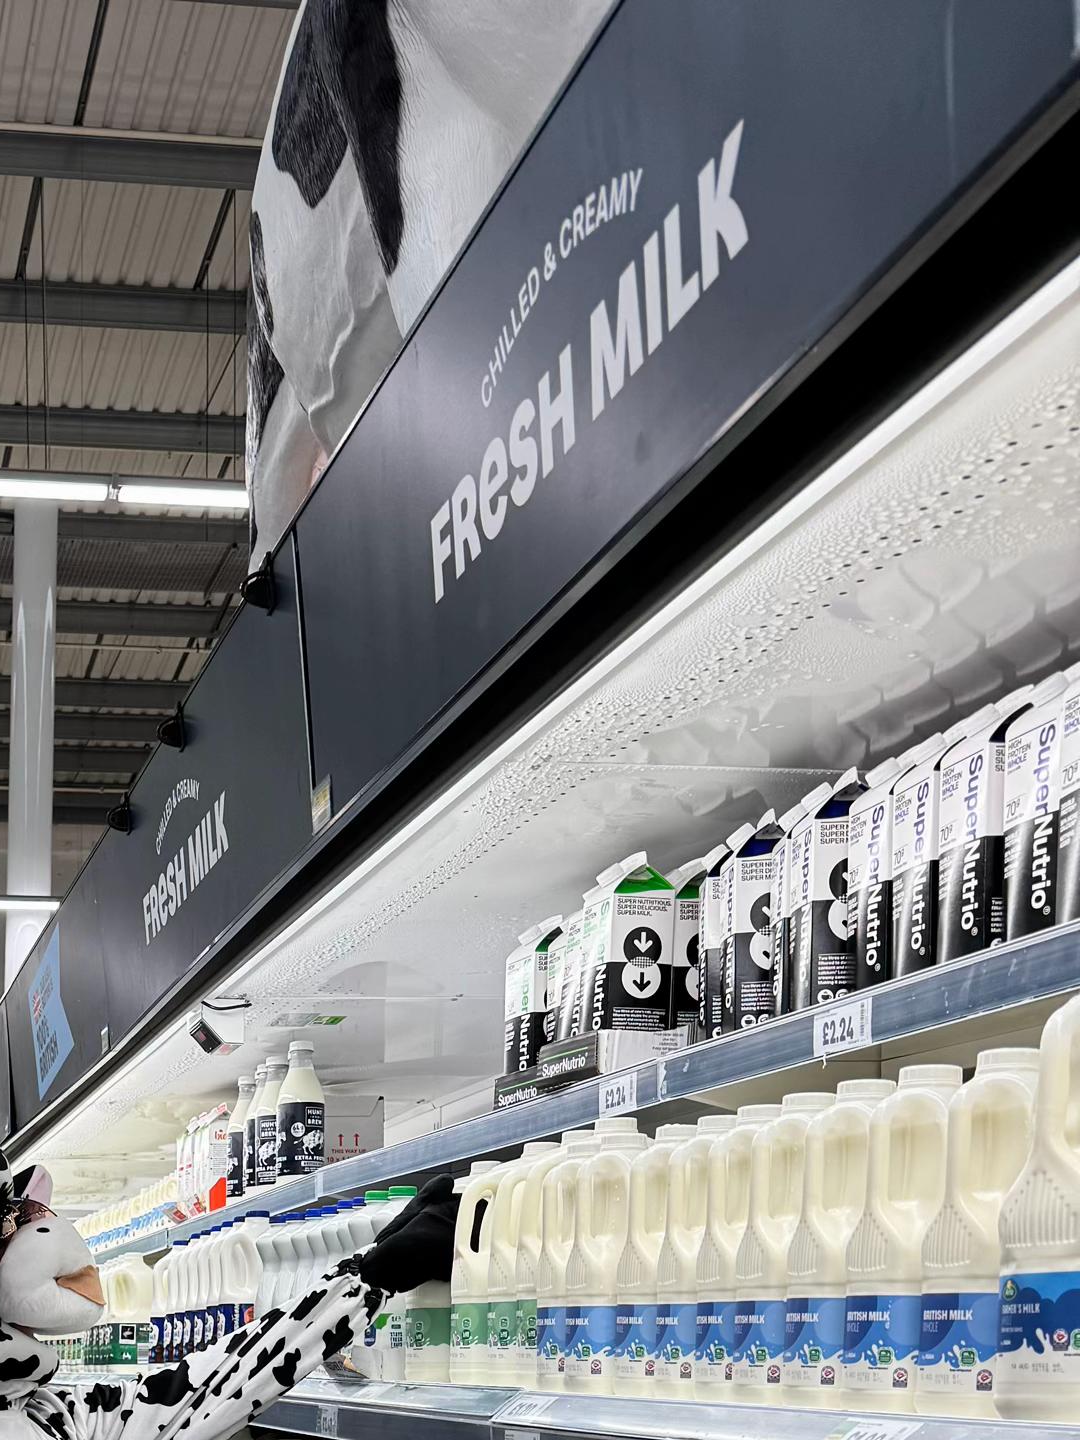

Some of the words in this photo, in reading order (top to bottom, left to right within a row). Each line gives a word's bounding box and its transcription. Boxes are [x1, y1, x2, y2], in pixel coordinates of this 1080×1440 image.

[590, 118, 749, 422] MILK
[480, 266, 540, 408] CHILLED
[543, 242, 557, 282] &
[559, 168, 643, 260] CREAMY
[176, 778, 200, 801] CREAMY
[1031, 723, 1057, 910] SuperNutrio
[187, 791, 229, 893] MILK
[961, 754, 984, 931] SuperNutrio
[866, 805, 885, 966] SuperNutrio
[822, 1016, 854, 1046] £2.24
[542, 1056, 586, 1078] SuperNutrio
[498, 1086, 537, 1107] SuperNutrio
[605, 1086, 626, 1109] £2.24
[801, 1313, 819, 1323] MILK
[868, 1311, 890, 1322] MILK
[949, 1309, 973, 1321] MILK
[1023, 1303, 1041, 1314] MILK
